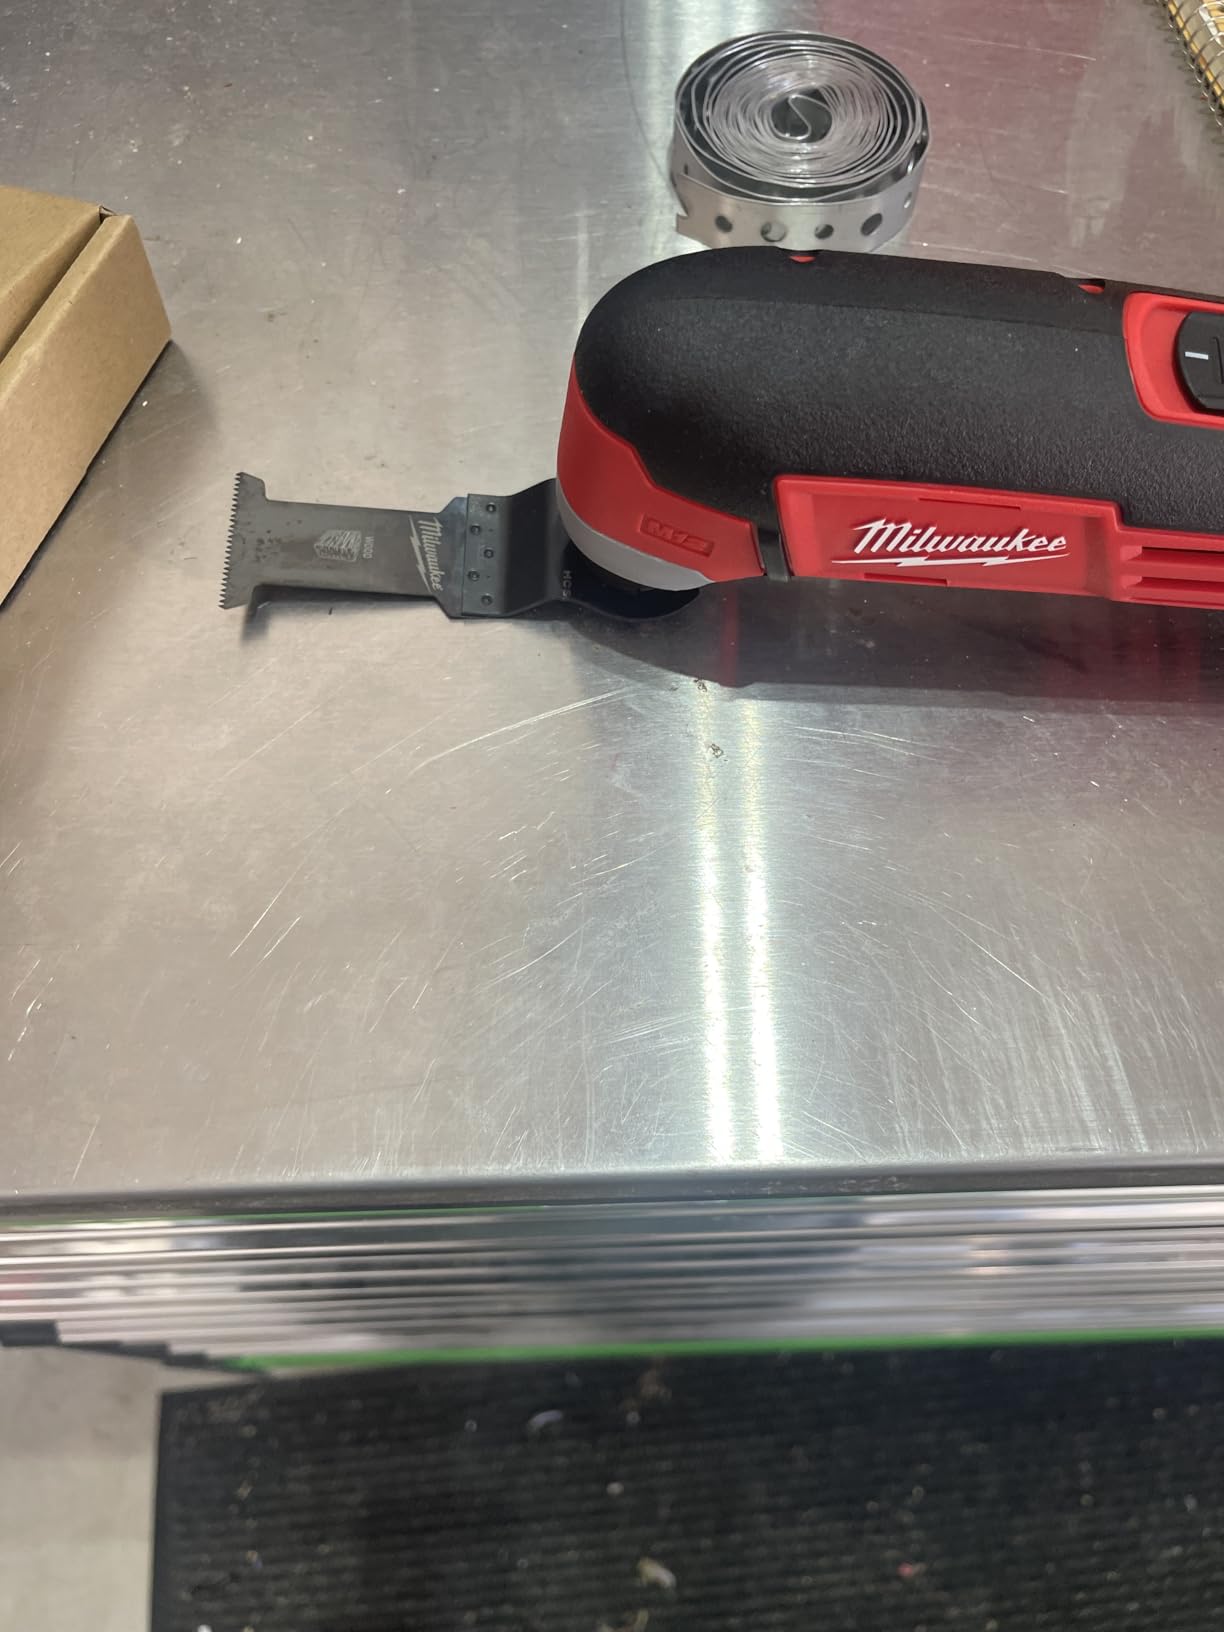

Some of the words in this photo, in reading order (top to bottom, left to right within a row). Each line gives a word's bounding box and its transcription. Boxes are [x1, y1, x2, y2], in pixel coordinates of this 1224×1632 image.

[362, 536, 375, 559] WOOD
[853, 518, 1067, 554] Milwaukee
[417, 517, 445, 592] Milwaukee
